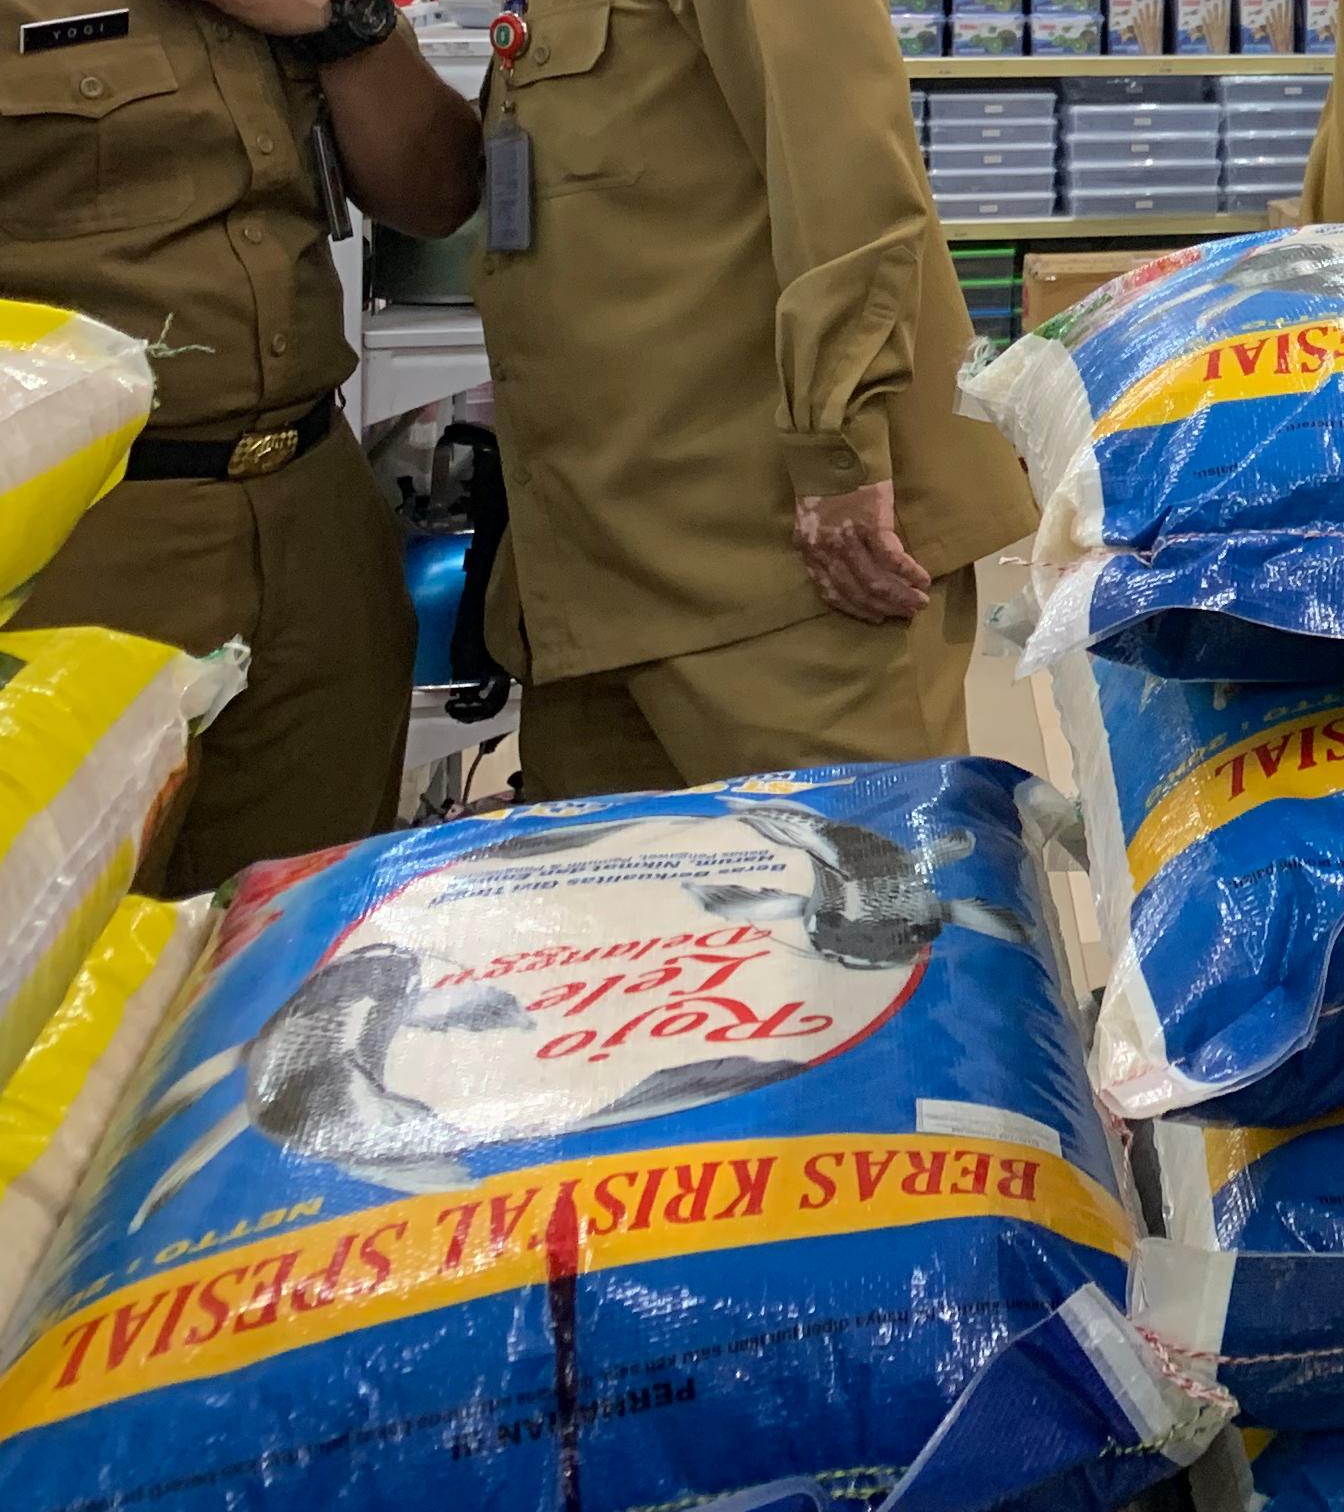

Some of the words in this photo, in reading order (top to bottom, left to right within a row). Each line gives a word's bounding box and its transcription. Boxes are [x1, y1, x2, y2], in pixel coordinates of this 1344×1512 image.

[434, 925, 772, 988] Delanggu
[524, 950, 771, 1019] Lele
[536, 996, 834, 1063] Rojo
[798, 1150, 1040, 1211] BERAS
[153, 1194, 325, 1265] NETTO
[53, 1220, 408, 1389] SPESIAL
